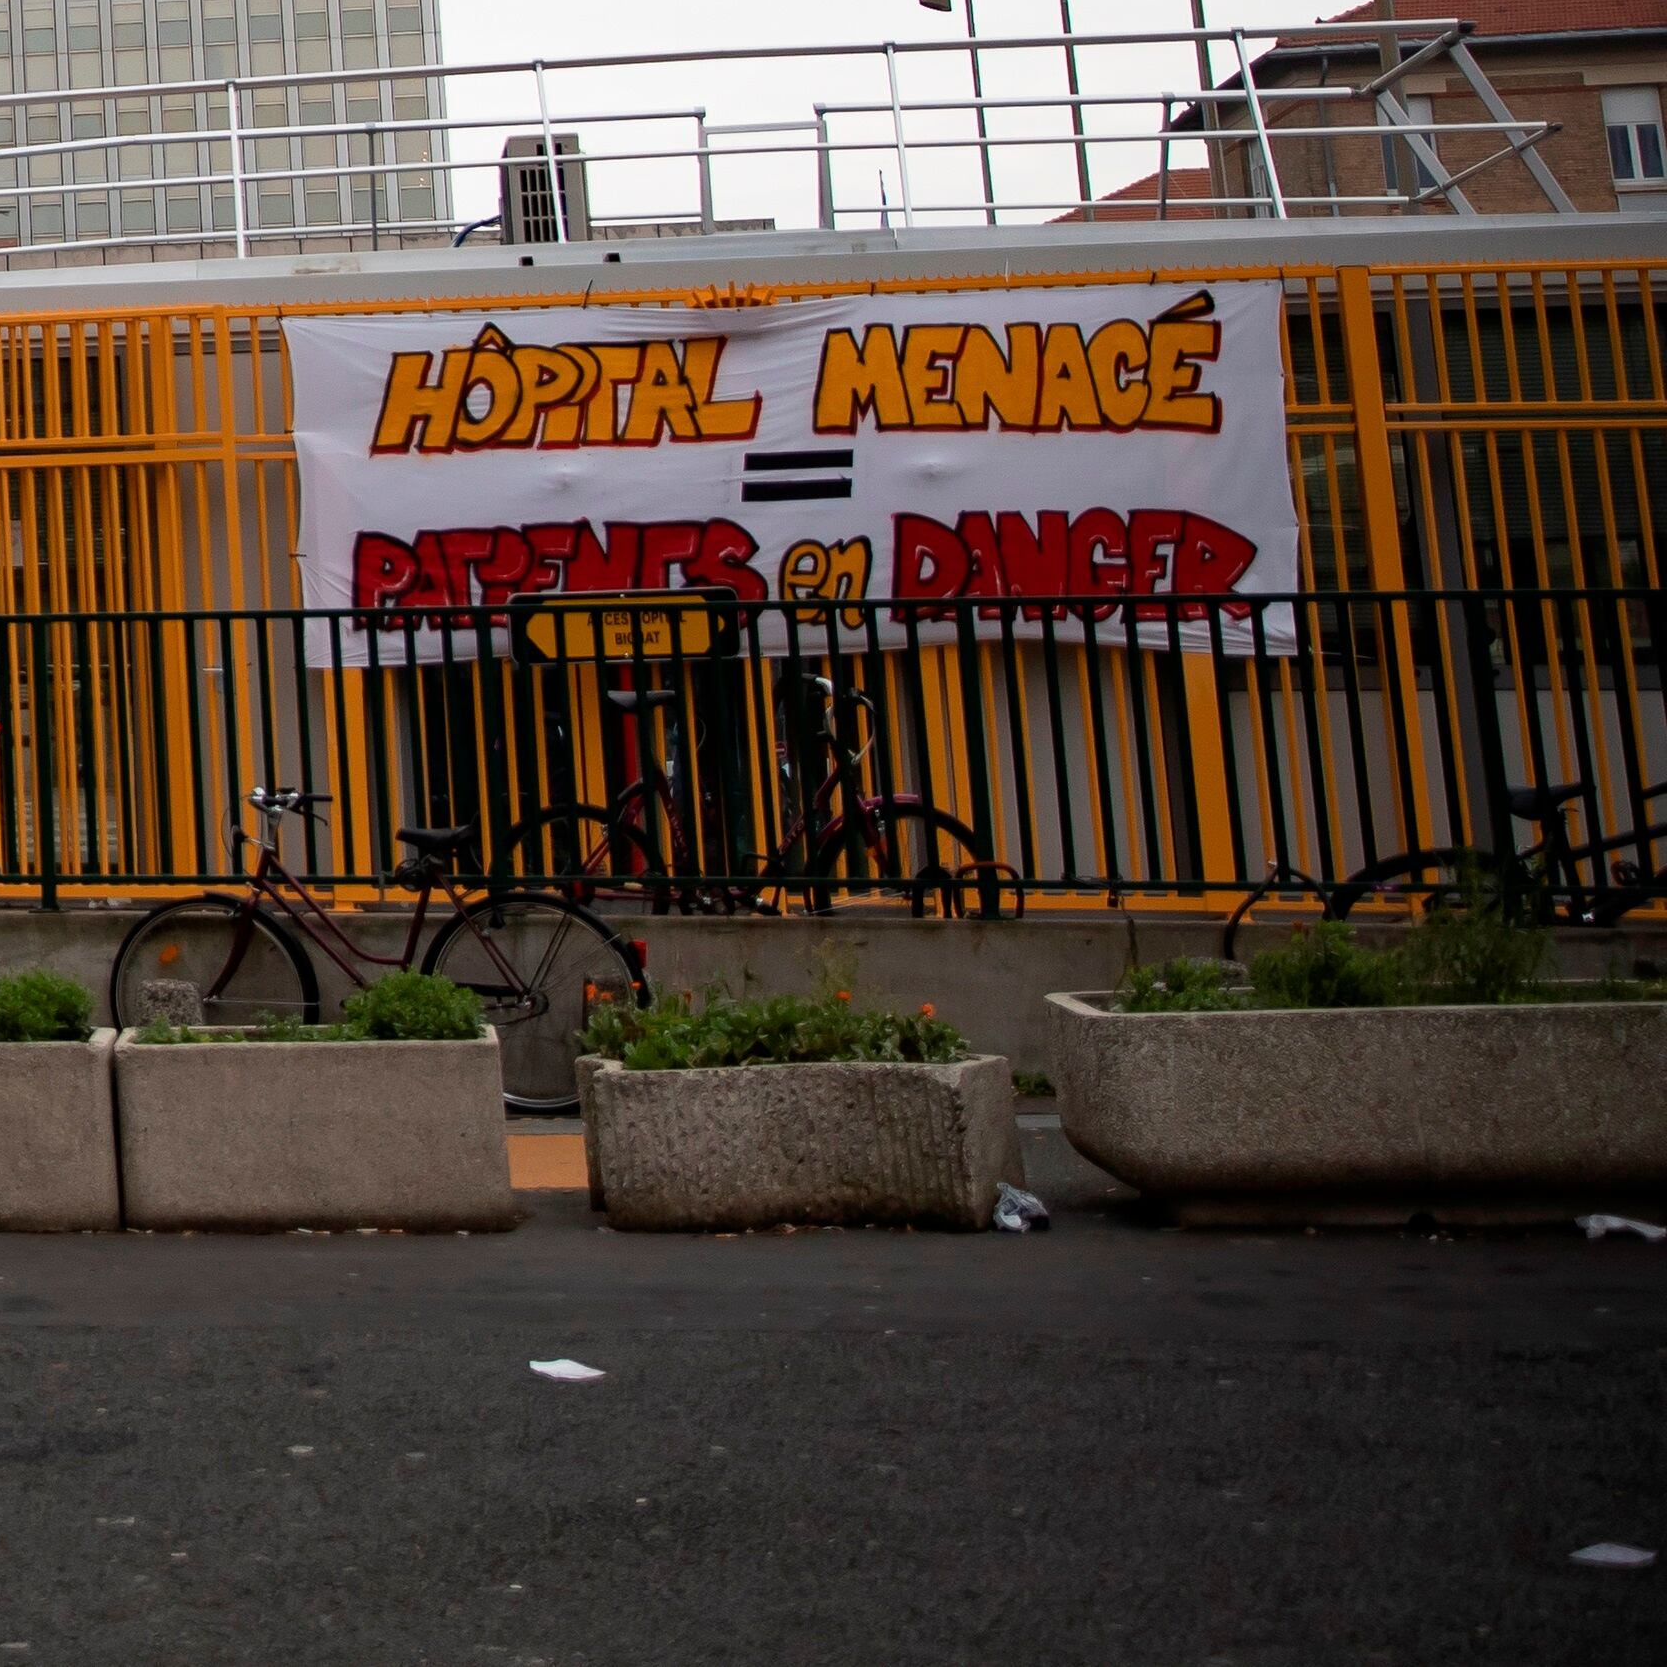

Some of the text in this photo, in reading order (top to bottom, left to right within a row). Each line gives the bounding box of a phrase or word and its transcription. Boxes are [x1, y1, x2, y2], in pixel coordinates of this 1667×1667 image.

[369, 289, 1222, 456] HÔPITAL MENACÉ
[352, 506, 1258, 631] PATIENTS en DANGER
[587, 612, 628, 626] ACES
[615, 631, 660, 645] BICAT
